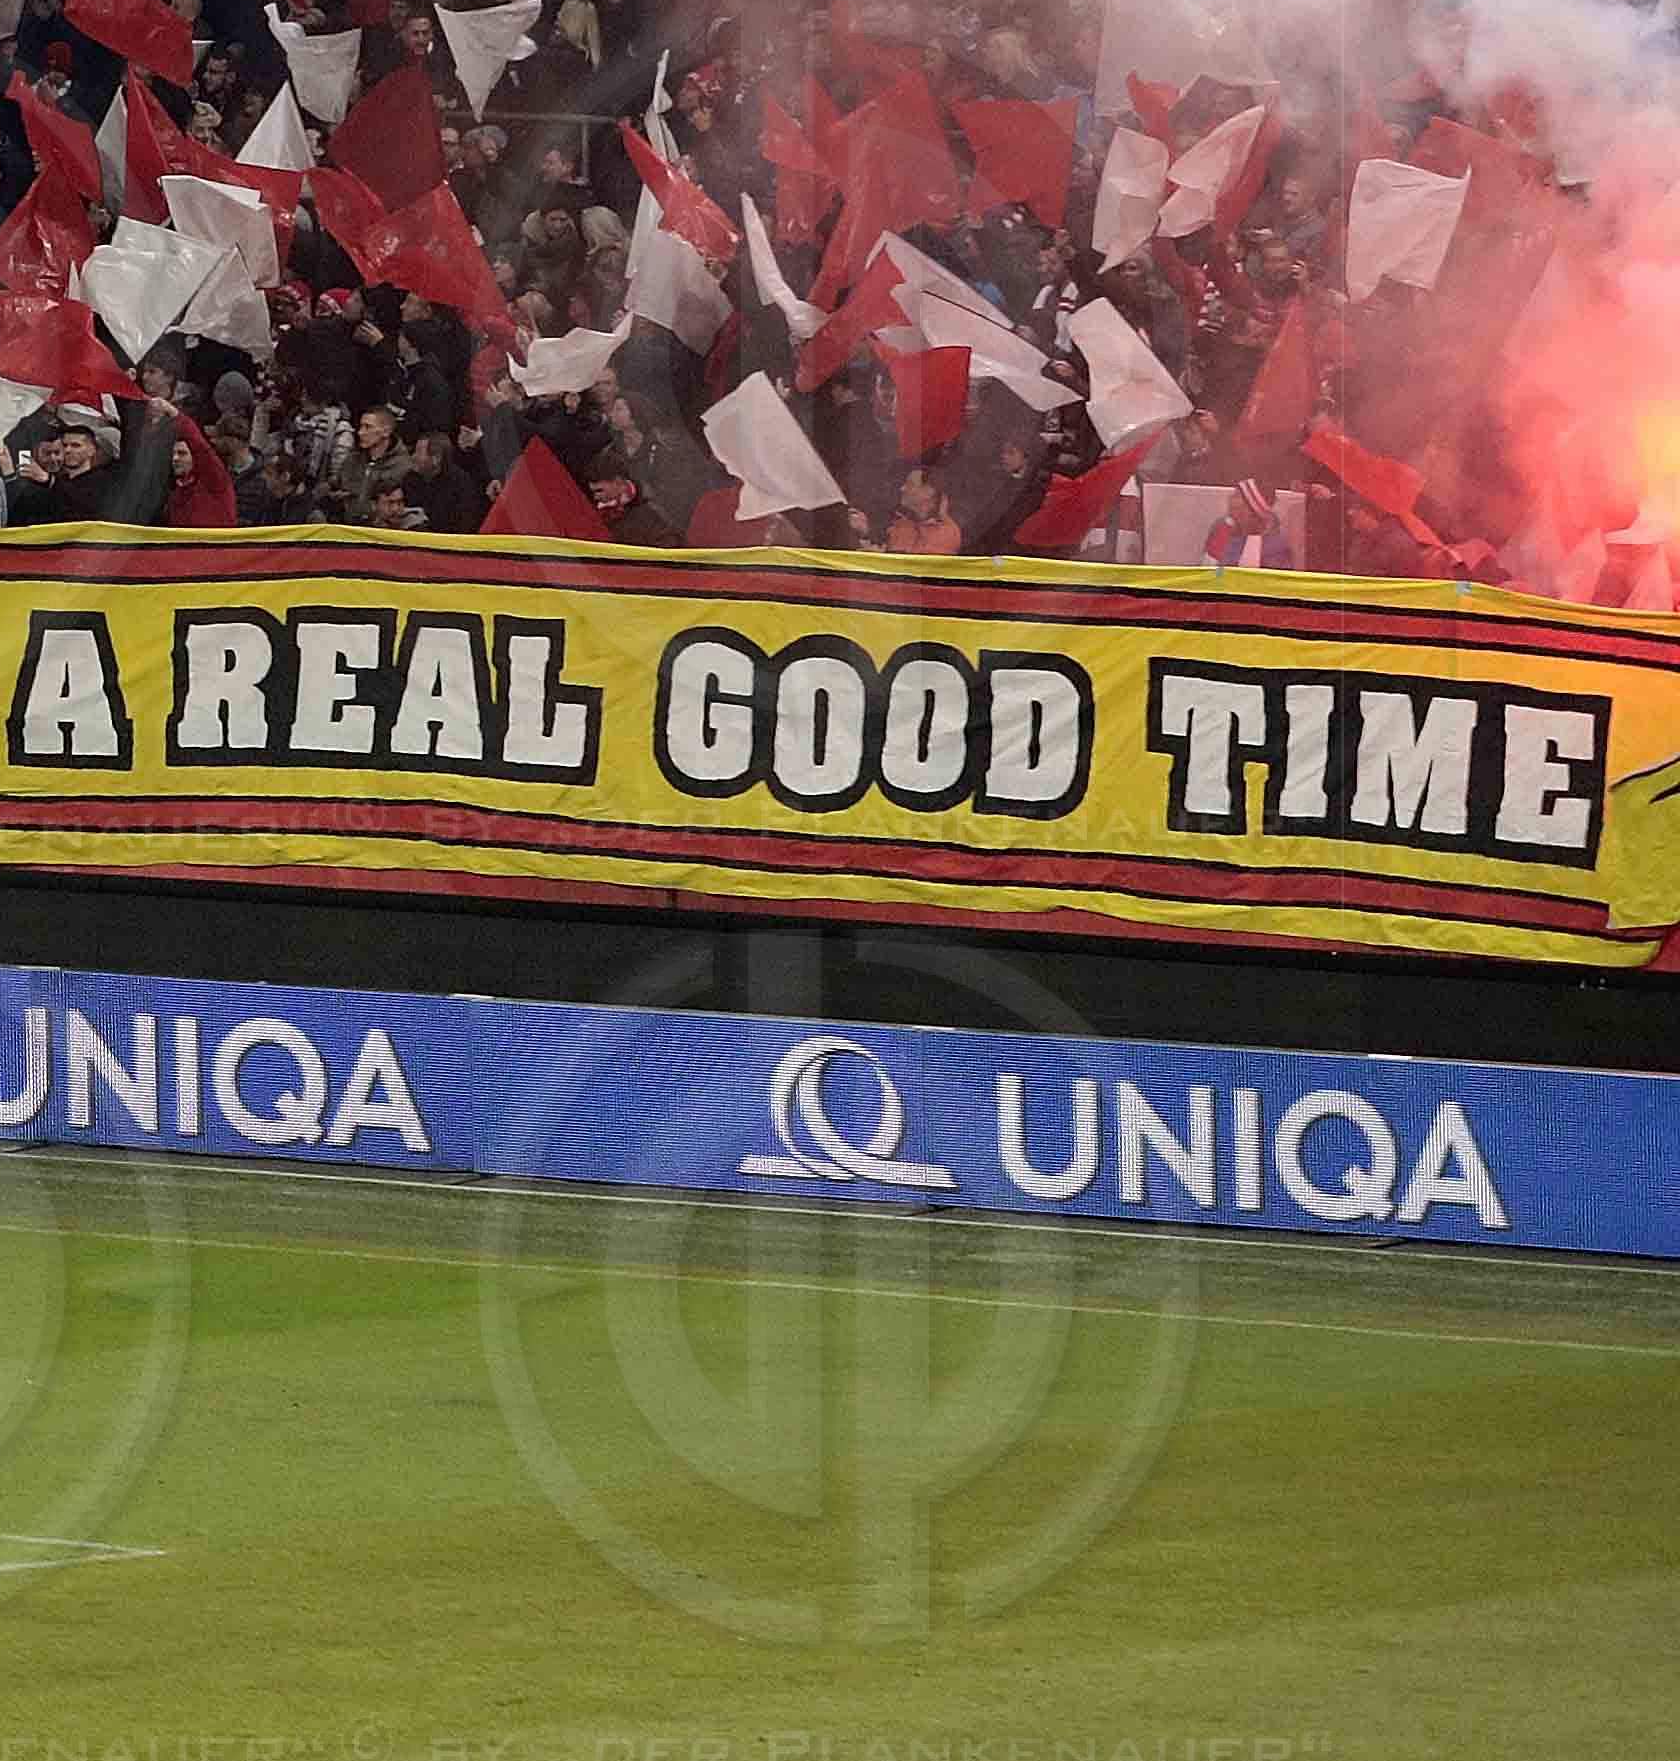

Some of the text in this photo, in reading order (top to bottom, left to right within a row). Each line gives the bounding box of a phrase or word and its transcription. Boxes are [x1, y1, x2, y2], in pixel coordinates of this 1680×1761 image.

[9, 611, 132, 768] A
[168, 607, 601, 785] REAL
[657, 628, 1091, 814] GOOD
[1150, 660, 1610, 867] TIME
[994, 1068, 1511, 1229] UNIQA
